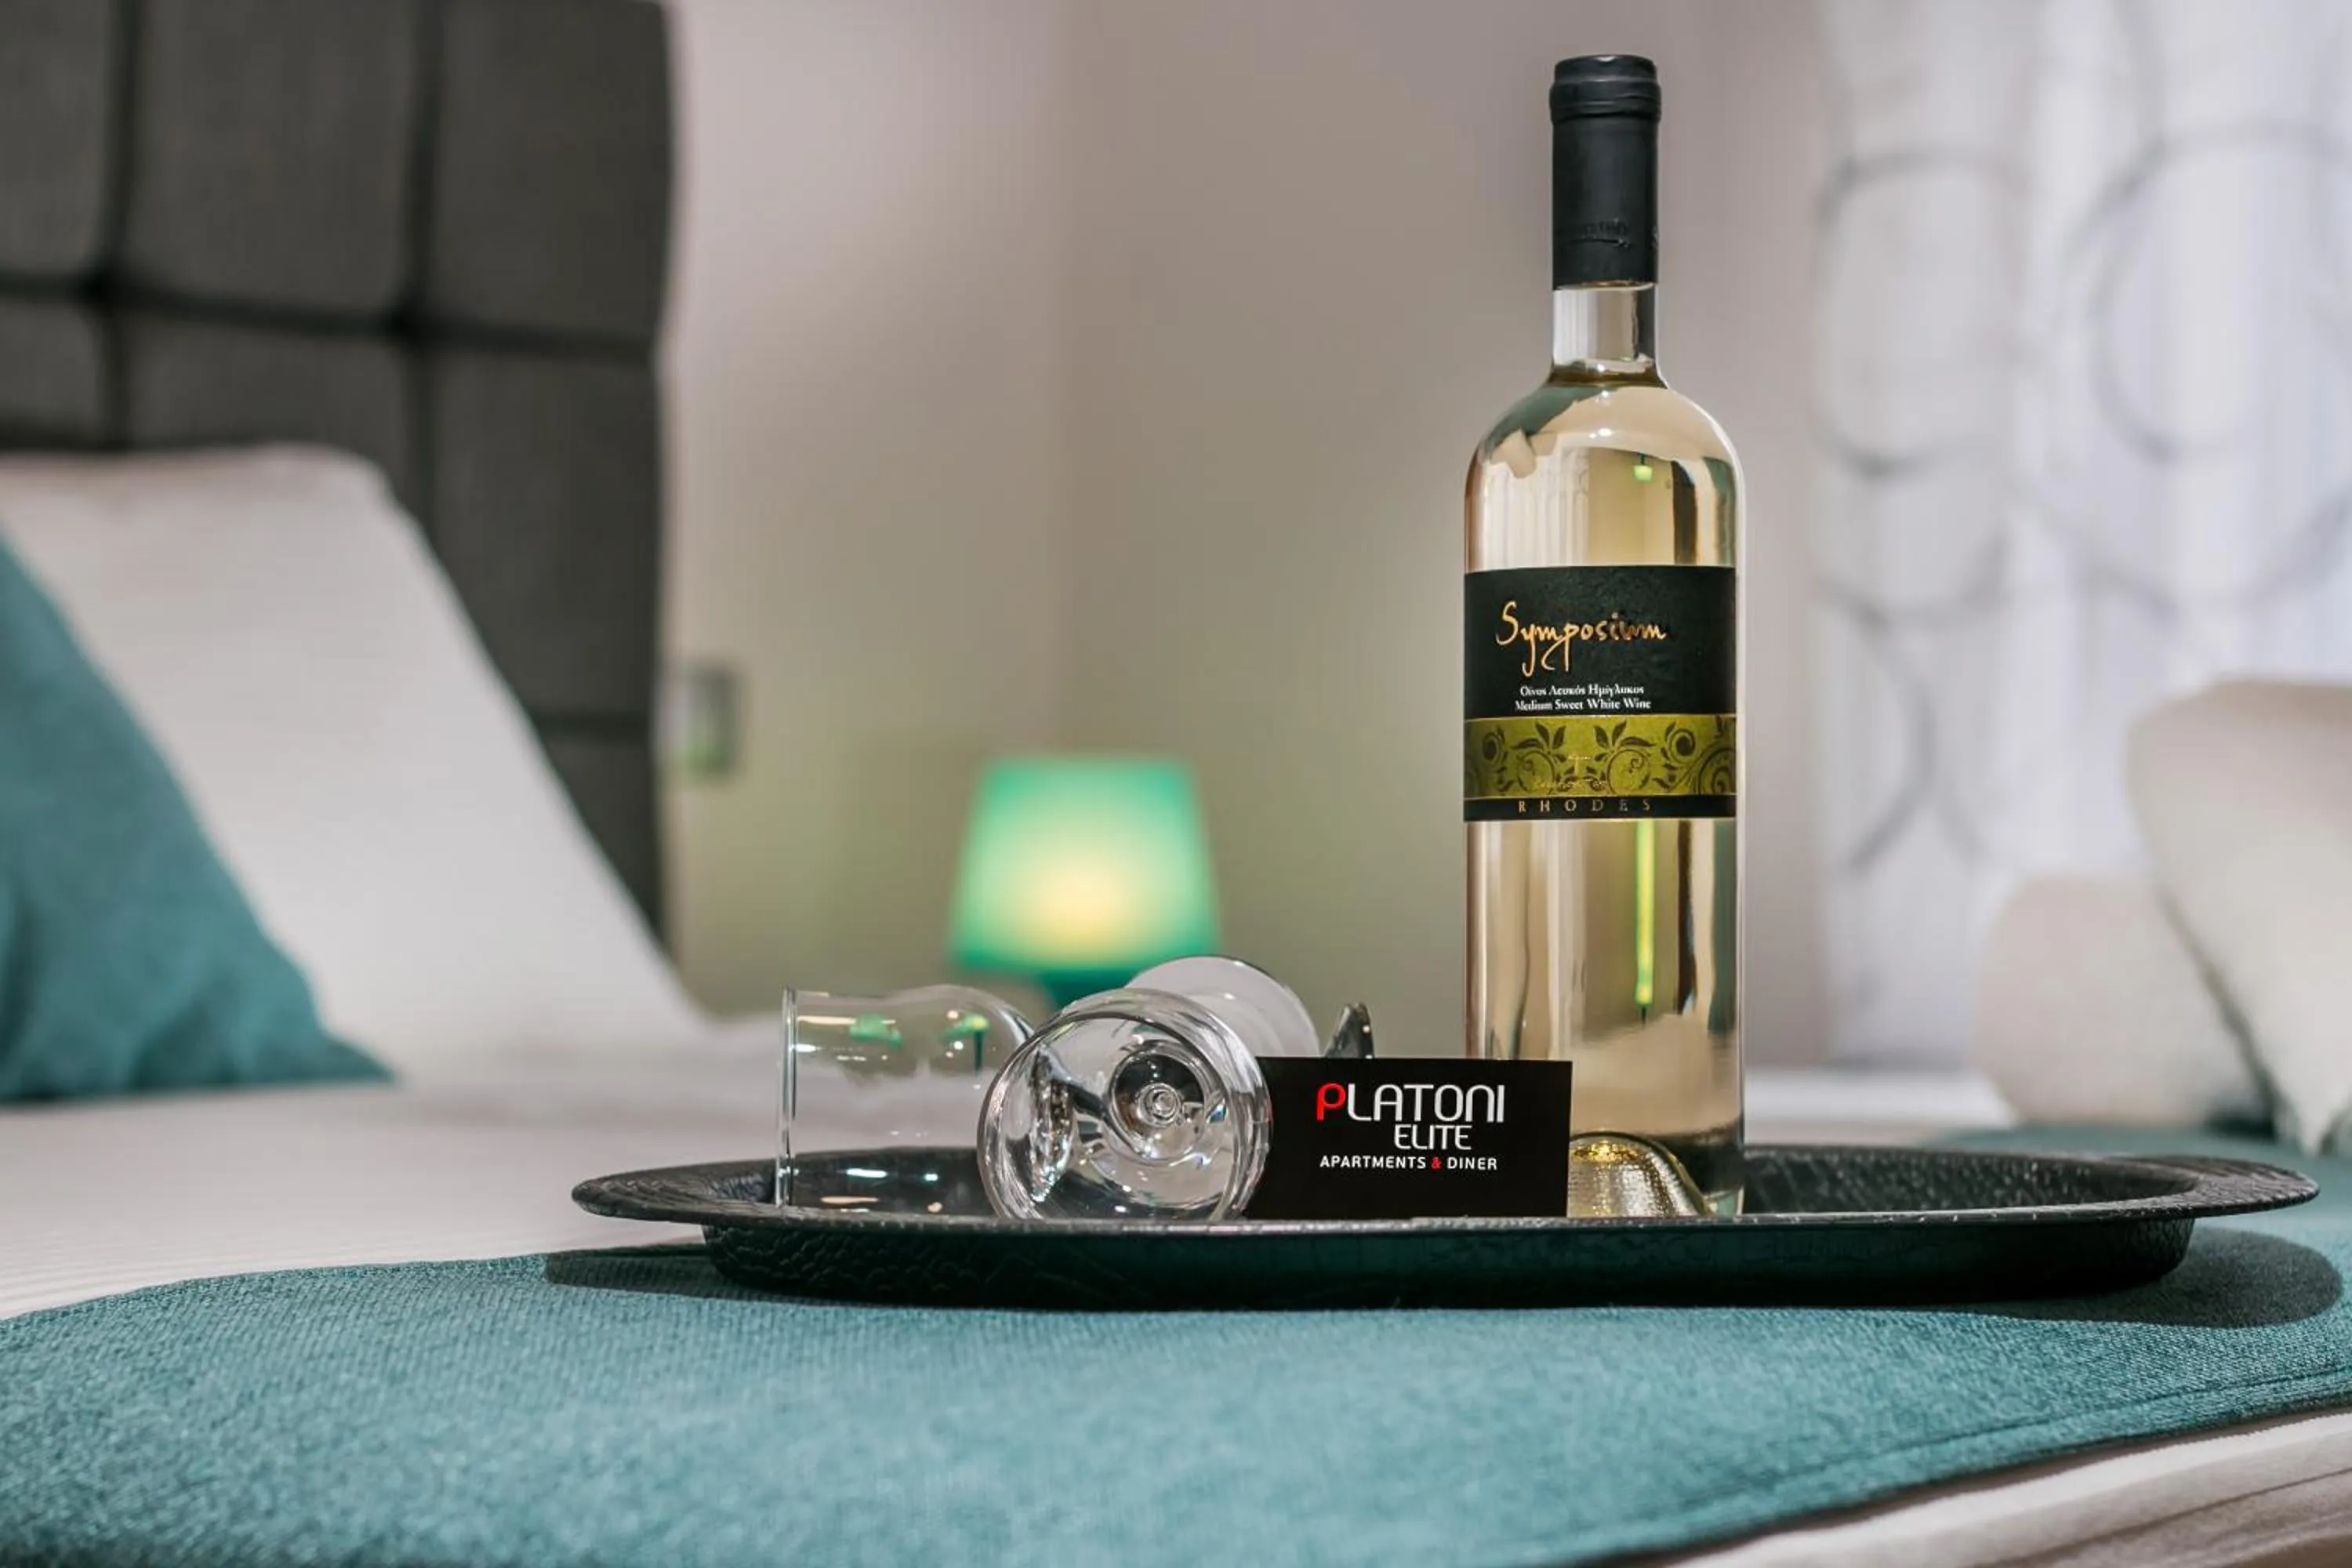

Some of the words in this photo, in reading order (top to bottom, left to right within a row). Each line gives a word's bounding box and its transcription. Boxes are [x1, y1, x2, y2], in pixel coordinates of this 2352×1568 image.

[1515, 700, 1553, 711] Medium
[1555, 699, 1584, 710] Sweet
[1586, 698, 1621, 710] White
[1623, 697, 1652, 710] Wine
[1316, 1082, 1505, 1123] PLATONI
[1394, 1123, 1472, 1150] ELITE
[1319, 1155, 1427, 1170] APARTMENTS
[1431, 1156, 1442, 1170] &
[1446, 1156, 1497, 1171] DINER
